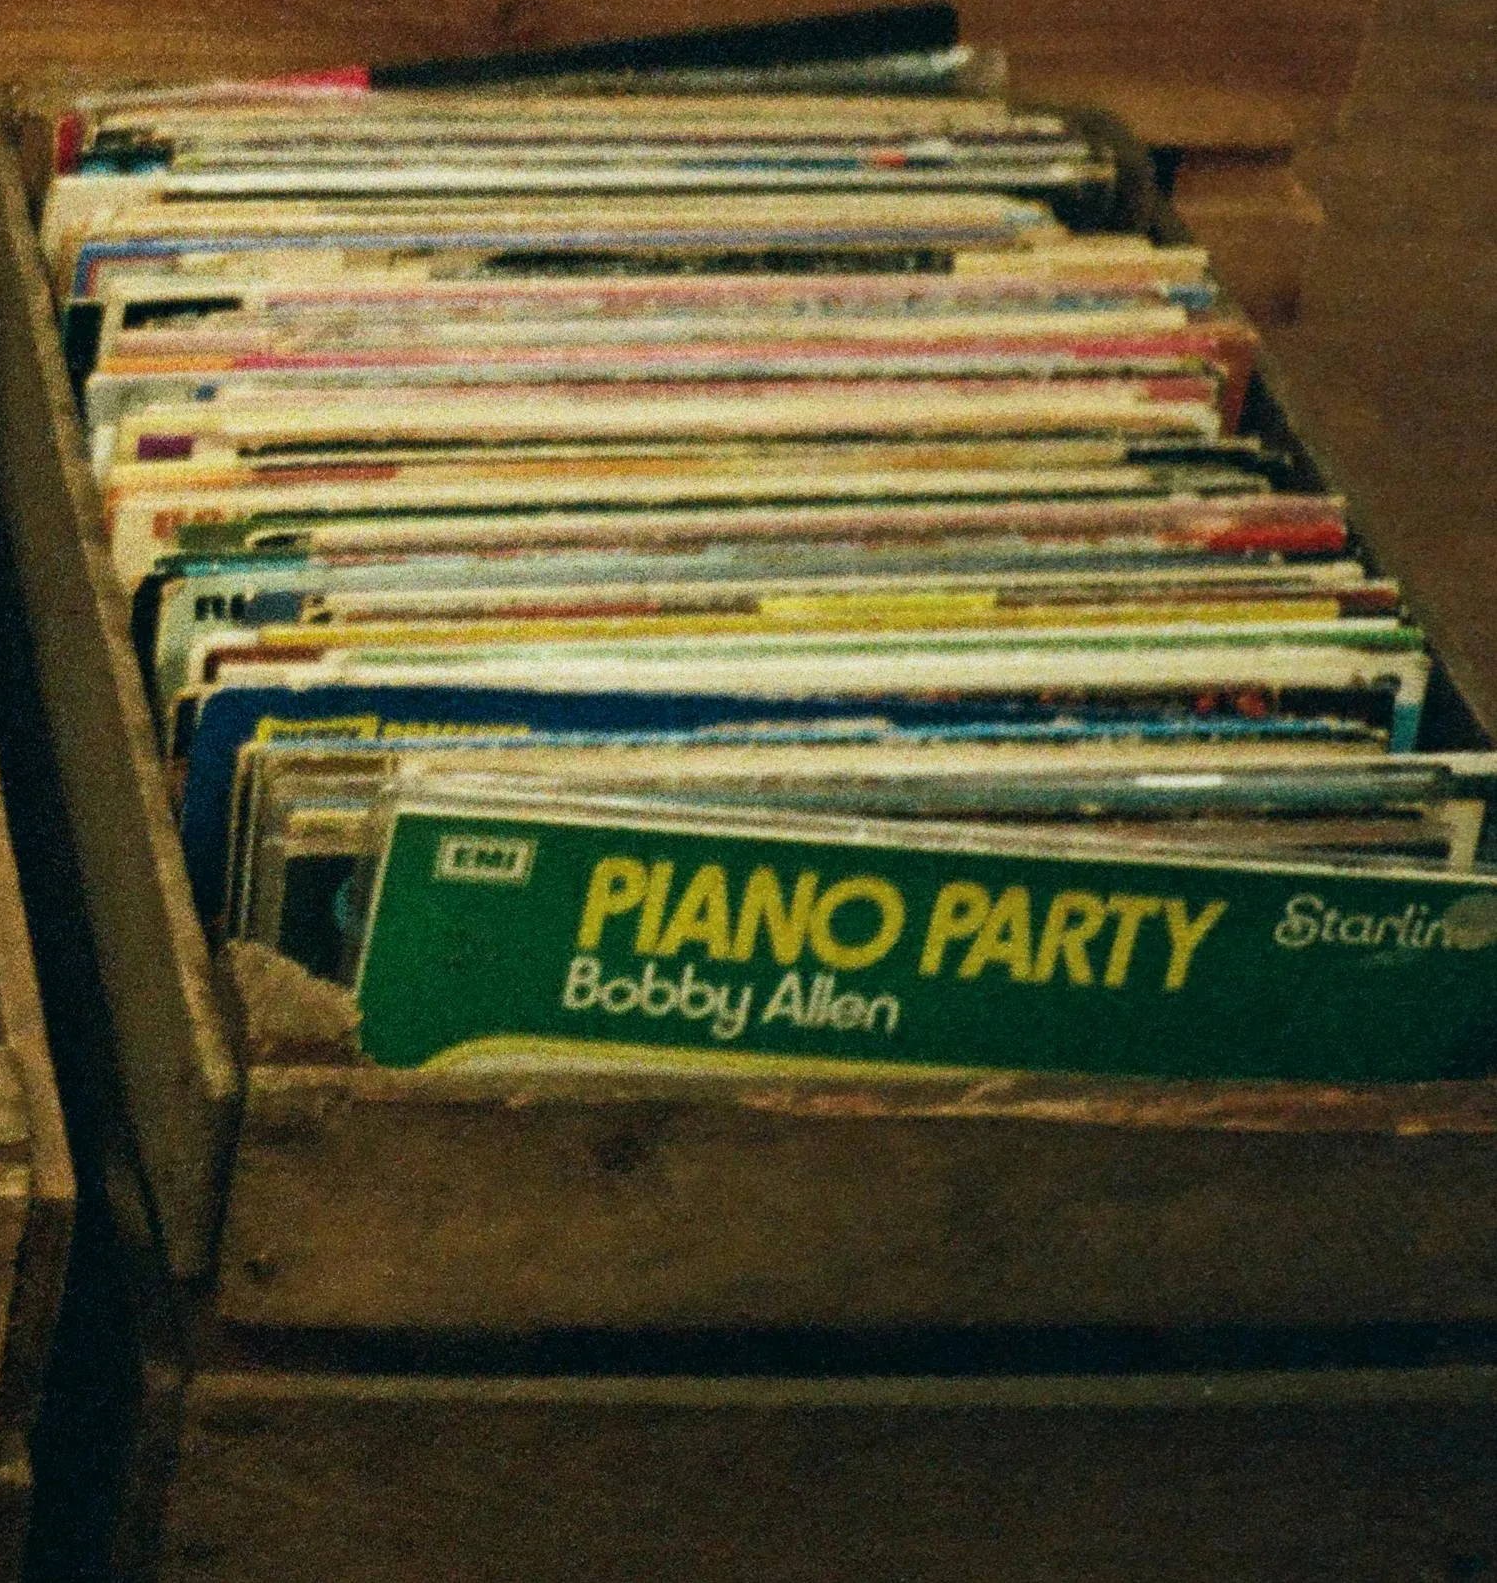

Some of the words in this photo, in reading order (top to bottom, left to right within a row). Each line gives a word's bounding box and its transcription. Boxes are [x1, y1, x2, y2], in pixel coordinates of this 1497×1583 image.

[575, 855, 907, 971] PIANO
[918, 880, 1229, 990] PARTY
[1272, 891, 1473, 950] Starlin
[561, 954, 755, 1042] Bobby
[761, 969, 903, 1032] Allen
